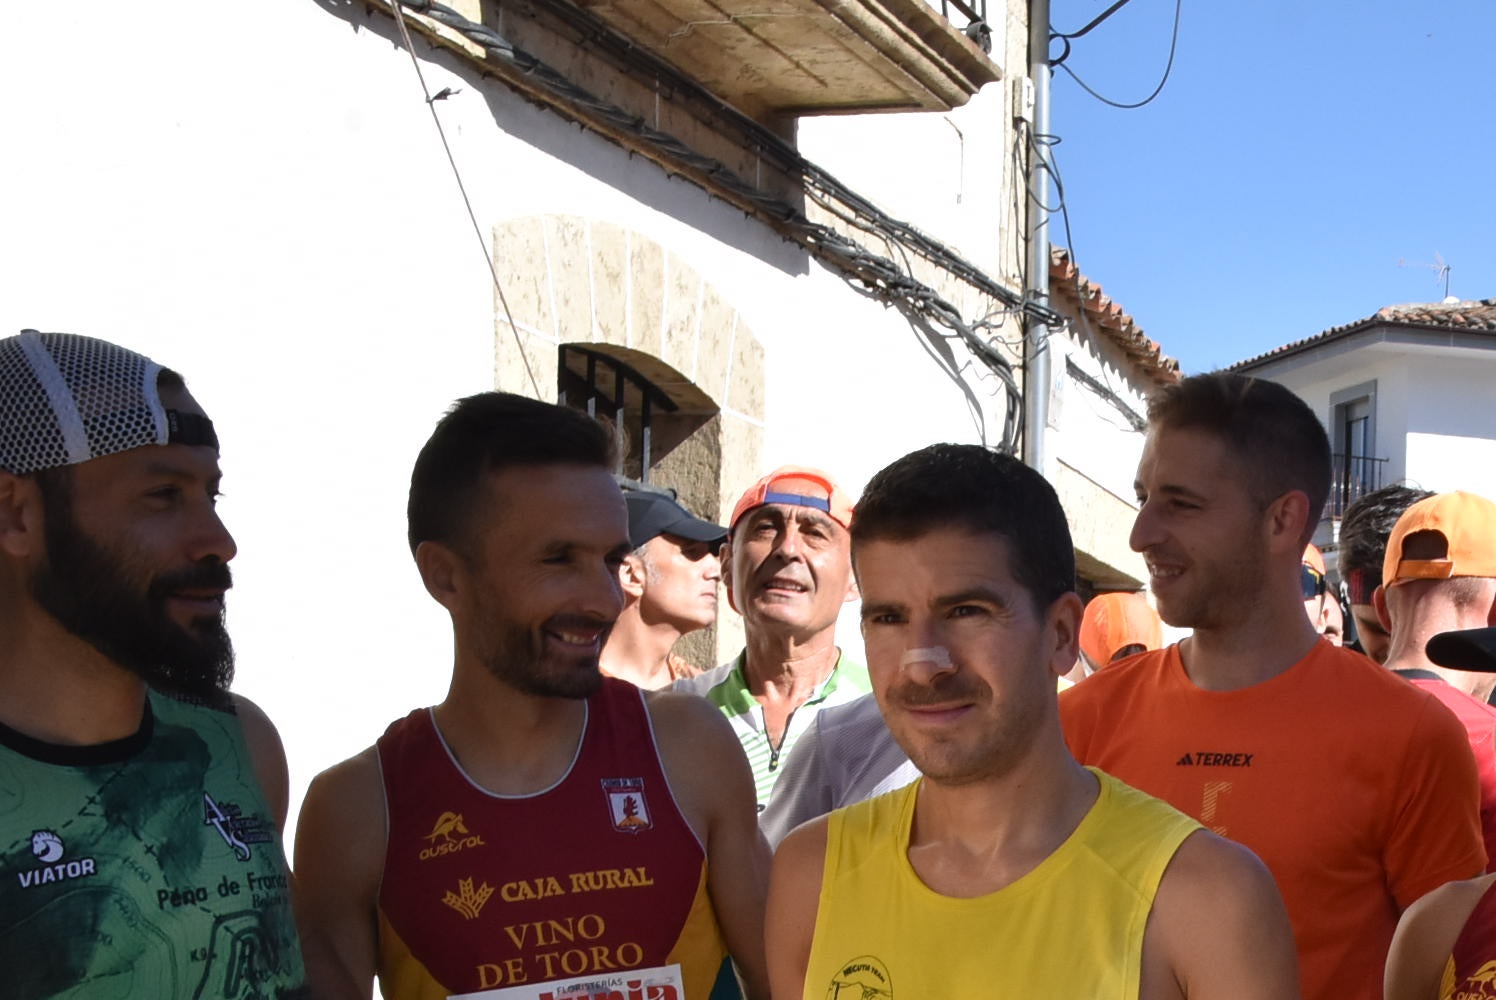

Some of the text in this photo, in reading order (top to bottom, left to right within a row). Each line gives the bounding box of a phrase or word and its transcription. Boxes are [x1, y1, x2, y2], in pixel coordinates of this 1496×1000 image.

[1195, 752, 1254, 767] TERREX
[419, 834, 485, 860] austral
[18, 858, 97, 889] VIATOR
[217, 875, 240, 898] de
[501, 867, 654, 902] CAJA RURAL
[504, 913, 605, 951] VINO
[476, 942, 644, 990] DE TORO
